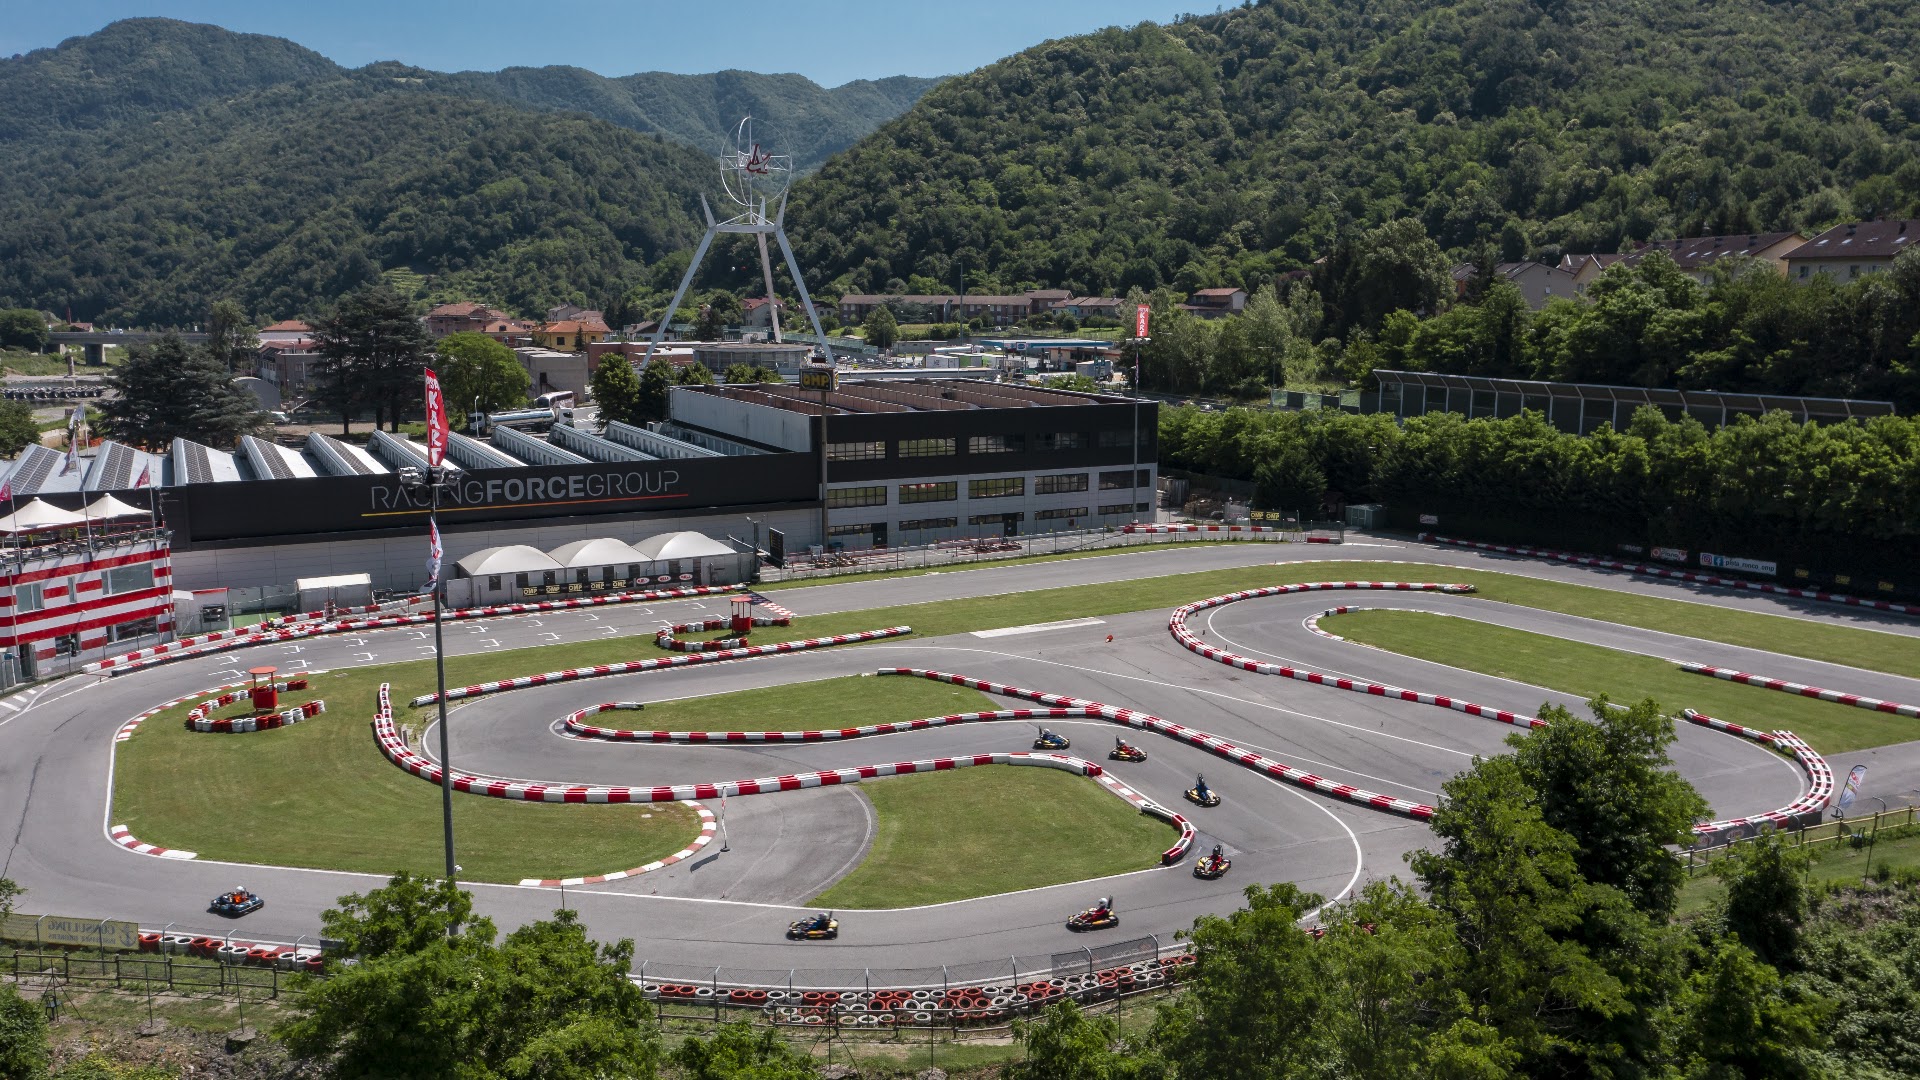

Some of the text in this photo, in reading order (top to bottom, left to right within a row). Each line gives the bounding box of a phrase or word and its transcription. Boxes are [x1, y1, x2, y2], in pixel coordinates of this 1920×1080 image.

[803, 373, 829, 386] OMP
[428, 390, 442, 466] KART
[1251, 511, 1264, 519] OMP
[1266, 512, 1279, 520] OMP
[523, 580, 626, 595] OMP OMP OMP OMP OMP
